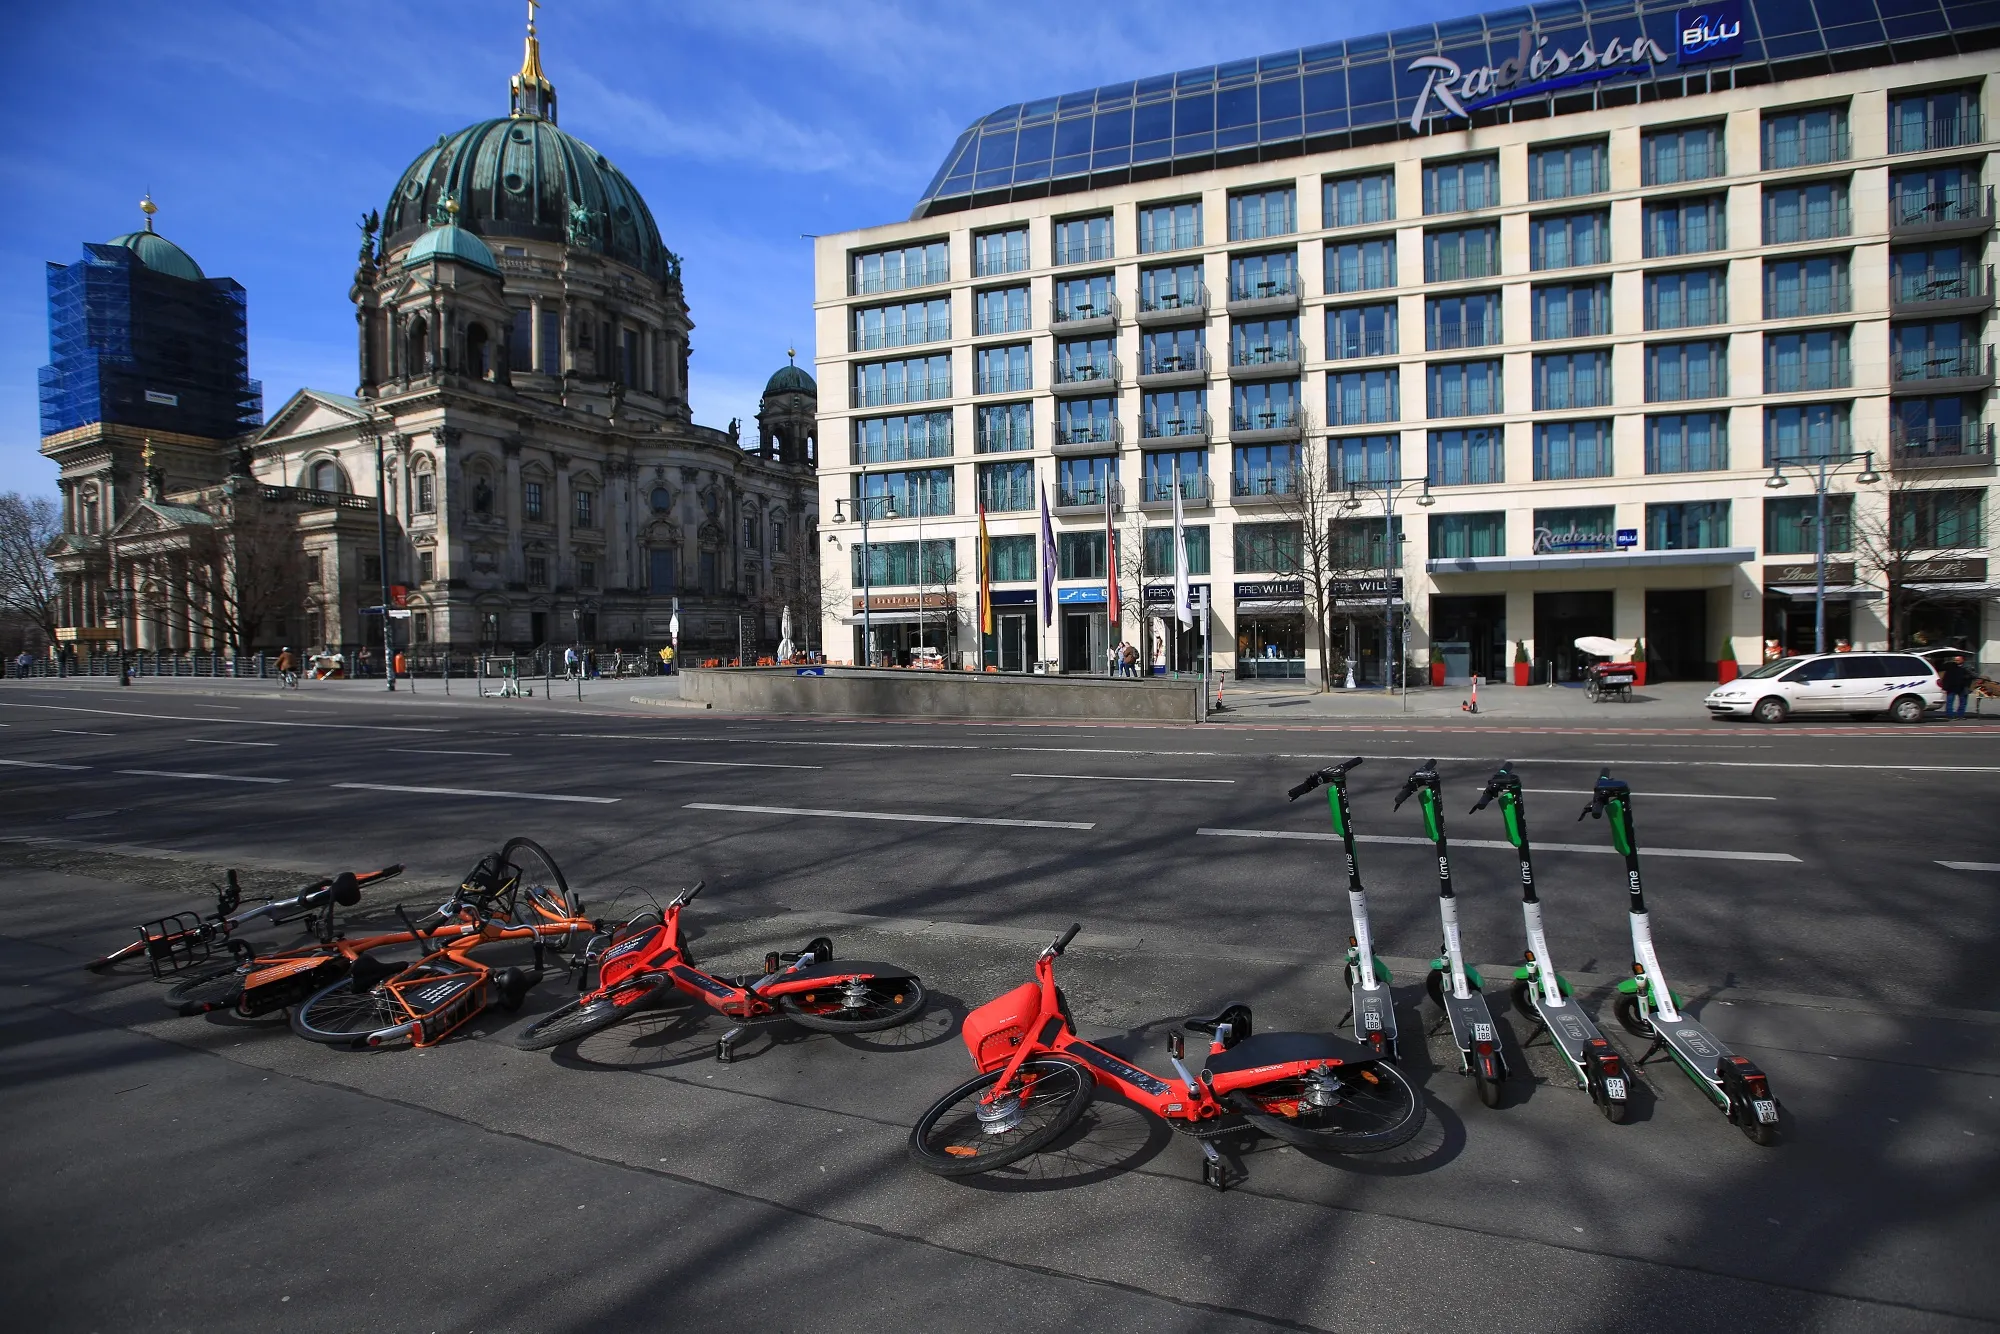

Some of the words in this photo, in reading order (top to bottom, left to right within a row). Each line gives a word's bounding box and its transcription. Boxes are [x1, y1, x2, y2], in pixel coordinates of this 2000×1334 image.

[1406, 27, 1667, 134] Radisson
[1682, 20, 1741, 46] BLU
[1533, 525, 1617, 551] Radisson
[1777, 566, 1820, 581] Lind
[1438, 856, 1449, 880] Lime
[1521, 861, 1532, 885] Lime
[1629, 870, 1640, 895] Lime
[1365, 1013, 1379, 1021] 194
[1476, 1024, 1490, 1032] 346
[1565, 1024, 1583, 1038] Lime
[1478, 1032, 1491, 1040] IBB
[1688, 1038, 1710, 1054] Lime
[1608, 1079, 1623, 1088] 891
[1610, 1088, 1625, 1098] IAZ
[1756, 1101, 1773, 1112] 959
[1761, 1111, 1778, 1121] IAZ
